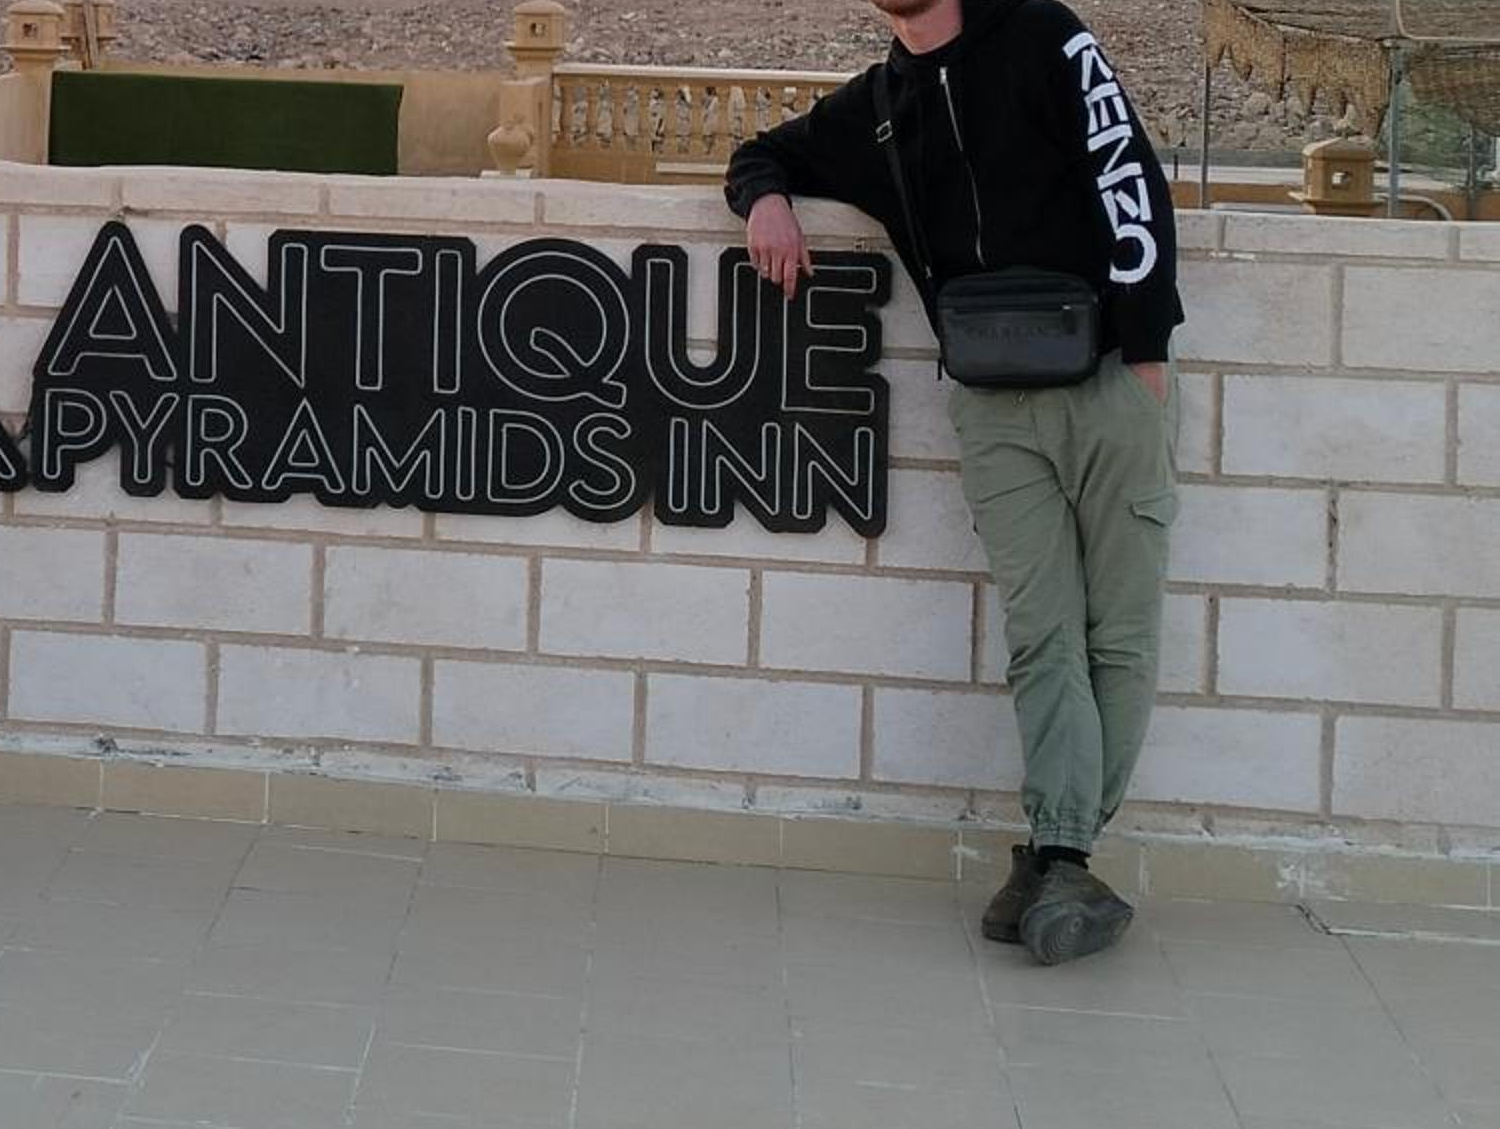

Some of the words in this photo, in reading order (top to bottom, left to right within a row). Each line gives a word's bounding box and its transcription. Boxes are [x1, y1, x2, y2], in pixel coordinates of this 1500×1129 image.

[1062, 31, 1158, 285] KENZO
[46, 235, 877, 416] ANTIQUE
[43, 387, 637, 511] PYRAMIDS
[667, 416, 875, 522] INN
